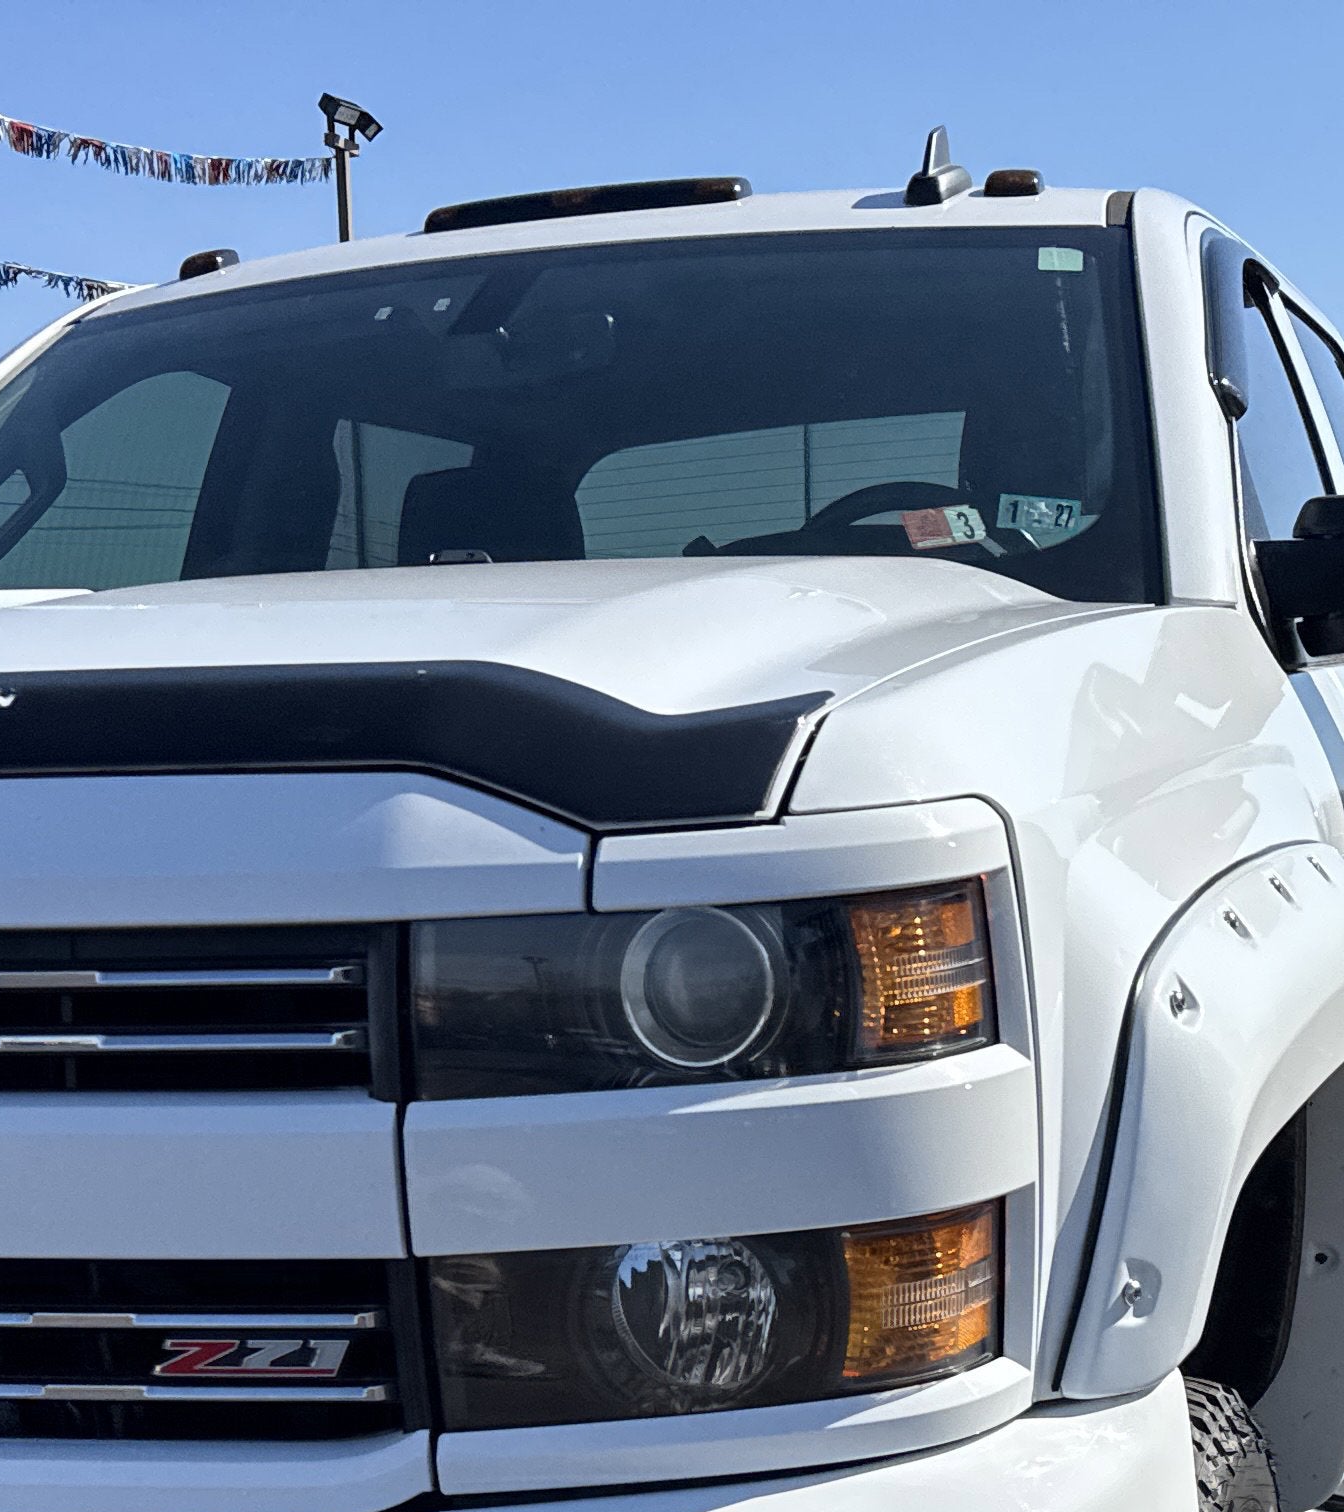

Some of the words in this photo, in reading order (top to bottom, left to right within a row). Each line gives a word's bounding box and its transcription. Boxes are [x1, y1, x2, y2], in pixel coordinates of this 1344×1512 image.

[956, 511, 976, 540] 3
[1056, 503, 1074, 528] 27
[153, 1339, 350, 1378] Z71
